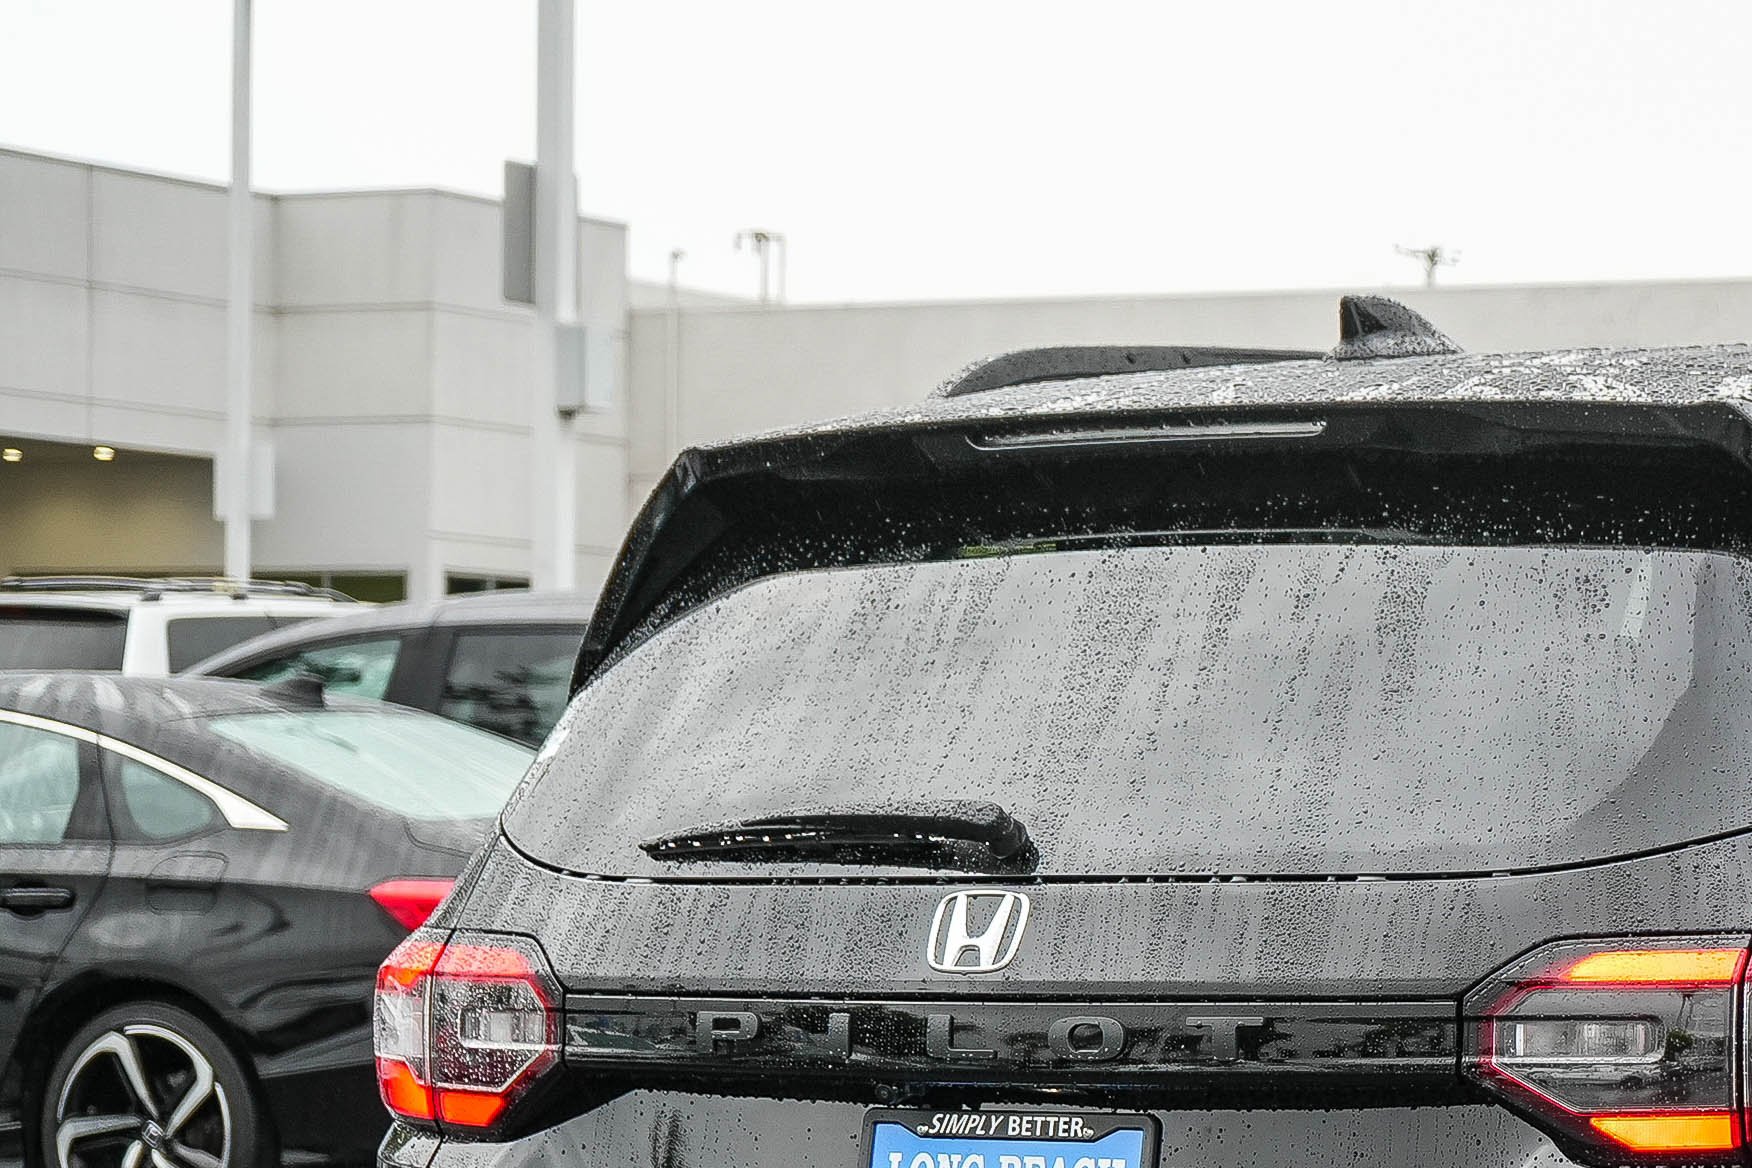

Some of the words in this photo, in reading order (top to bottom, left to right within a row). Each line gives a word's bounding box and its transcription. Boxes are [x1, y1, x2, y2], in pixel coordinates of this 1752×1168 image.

[697, 1010, 1264, 1062] PILOT
[929, 1114, 1002, 1135] SIMPLY
[1007, 1116, 1083, 1138] BETTER
